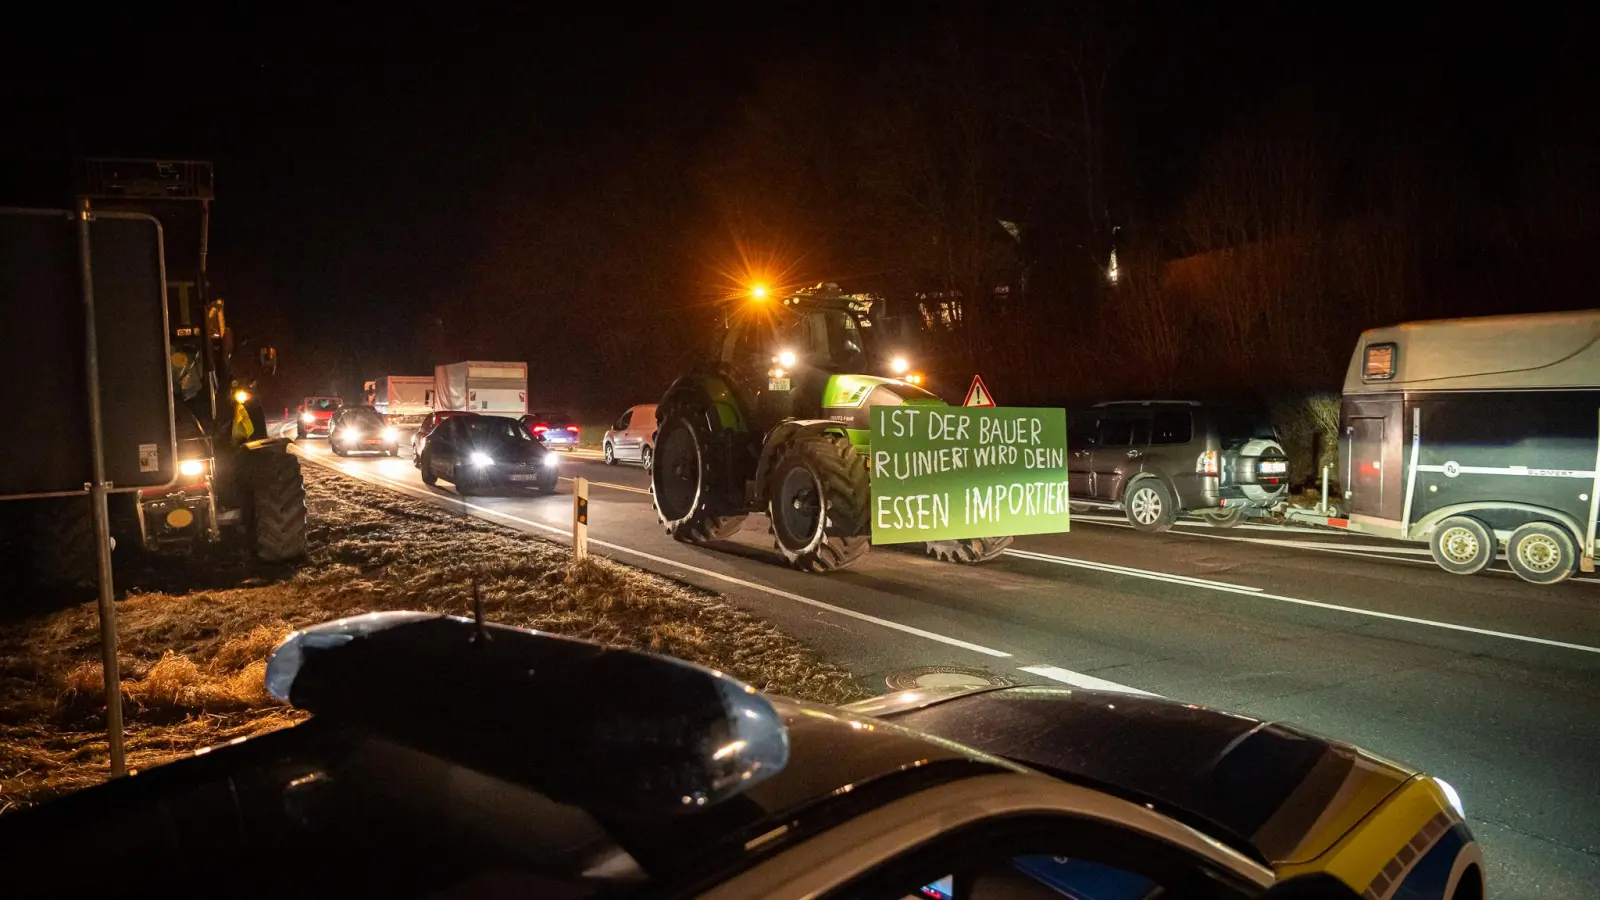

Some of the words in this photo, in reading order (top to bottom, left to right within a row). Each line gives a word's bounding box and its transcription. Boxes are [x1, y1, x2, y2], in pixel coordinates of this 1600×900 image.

[880, 410, 919, 437] IST
[928, 411, 970, 441] DER
[979, 416, 1042, 445] BAUER
[875, 447, 969, 480] RUINIERT
[973, 445, 1018, 468] WIRD
[1024, 448, 1063, 469] DEIN
[877, 492, 949, 530] ESSEN
